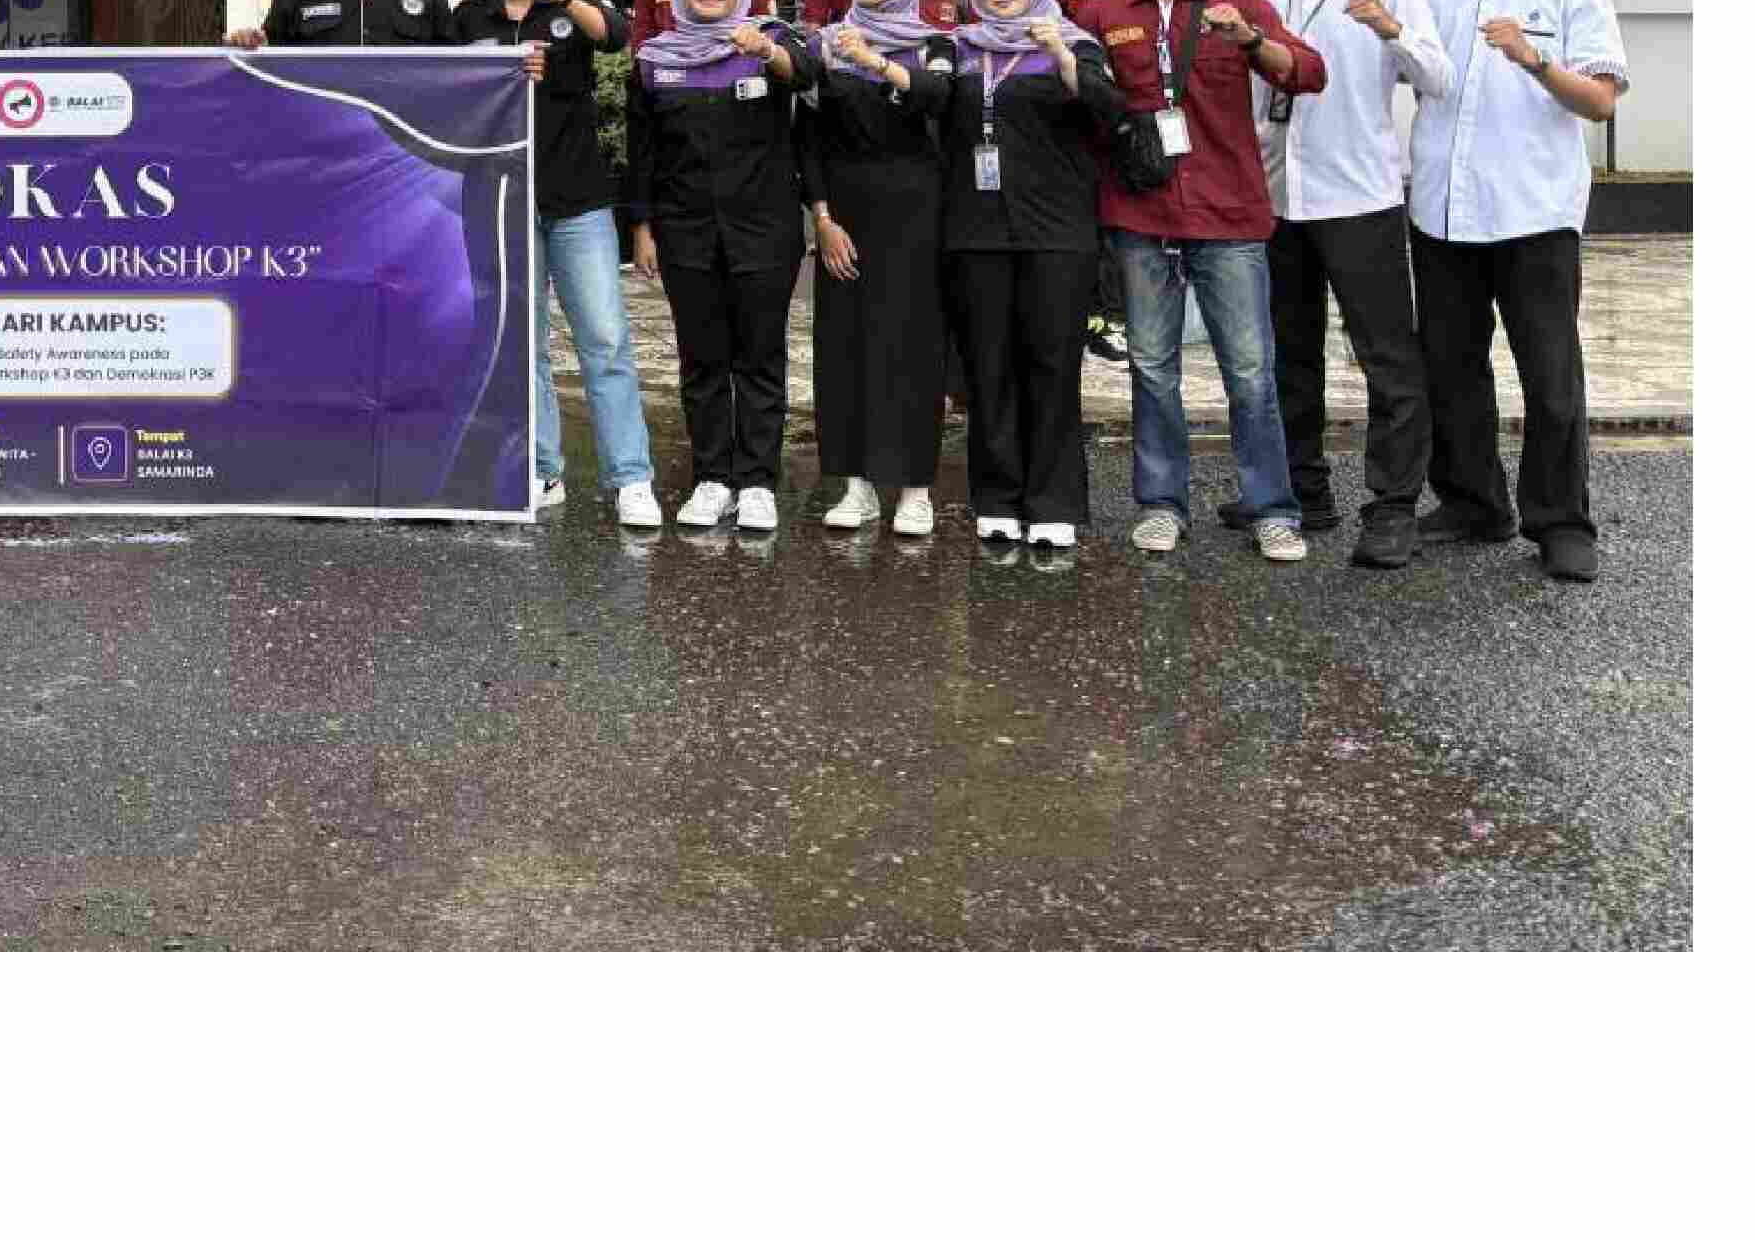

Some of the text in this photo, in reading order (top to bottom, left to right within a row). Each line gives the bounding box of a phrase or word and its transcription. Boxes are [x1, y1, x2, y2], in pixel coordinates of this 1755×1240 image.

[39, 244, 253, 279] WORKSHOP
[50, 312, 166, 333] KAMPUS:
[47, 346, 126, 360] Awareness
[129, 346, 170, 363] pada
[73, 367, 103, 381] dan
[134, 429, 186, 444] Tempat
[137, 448, 175, 460] BALAI
[137, 465, 215, 479] SAMARINDA
